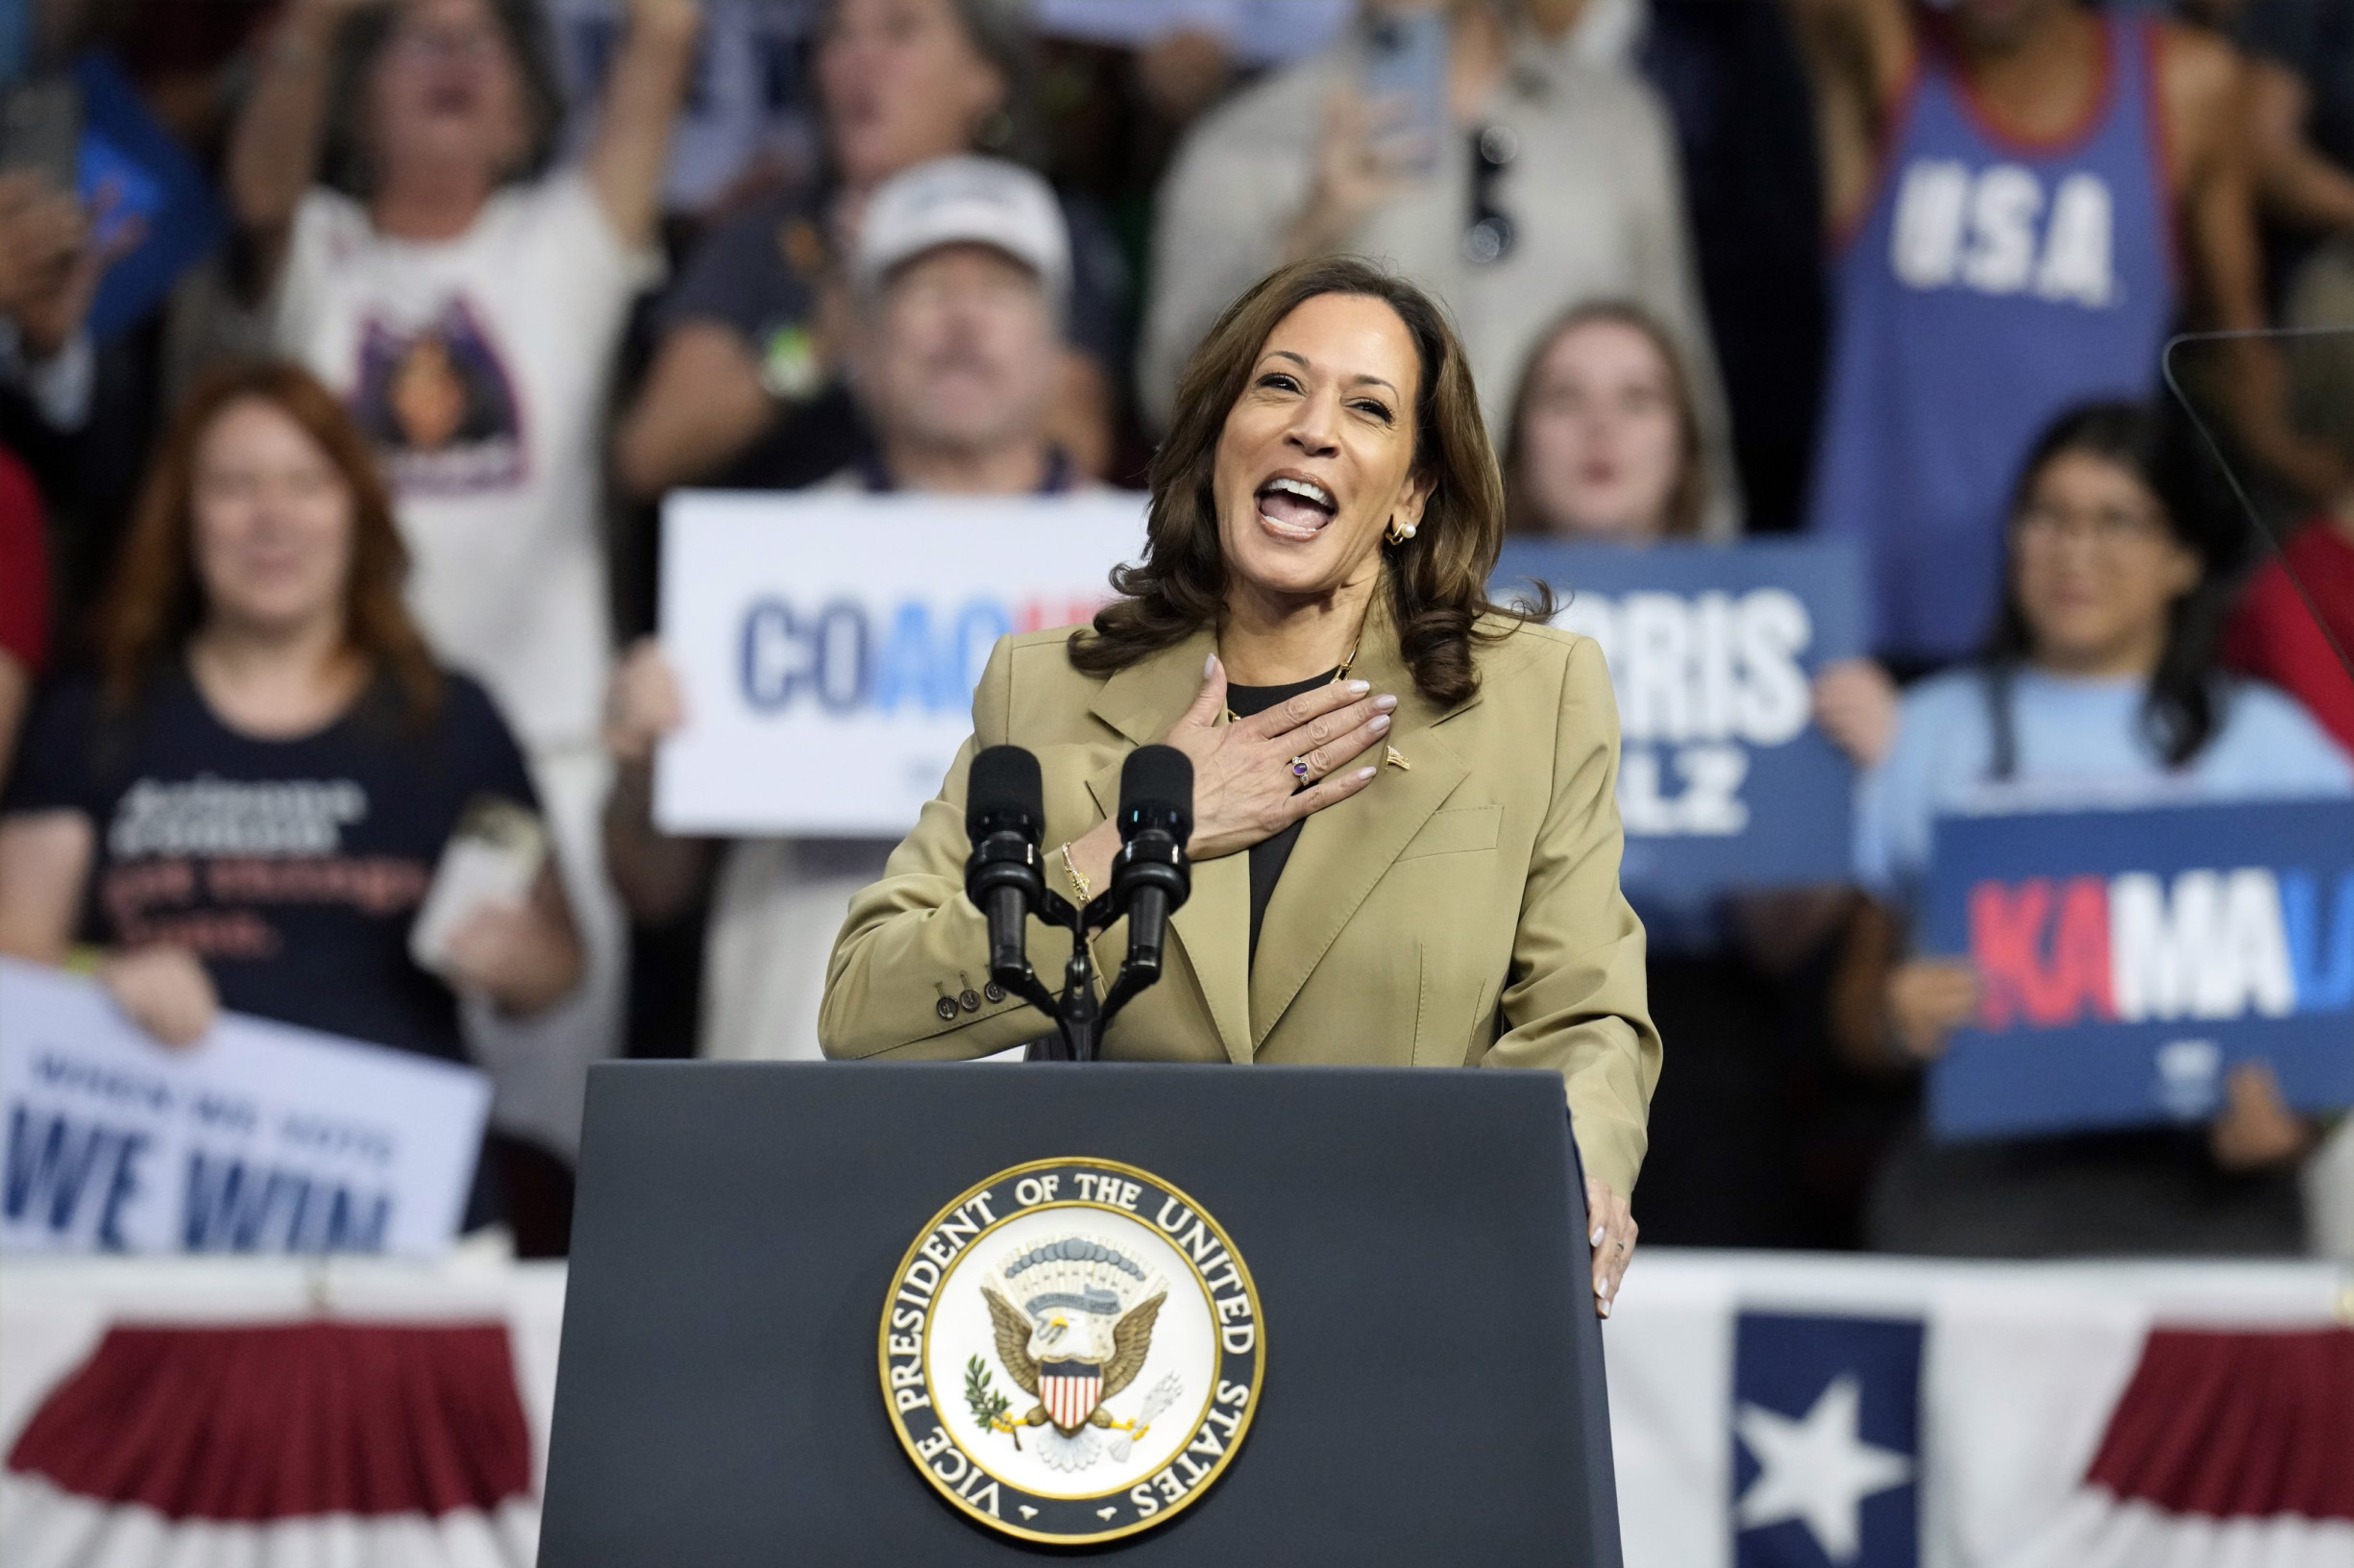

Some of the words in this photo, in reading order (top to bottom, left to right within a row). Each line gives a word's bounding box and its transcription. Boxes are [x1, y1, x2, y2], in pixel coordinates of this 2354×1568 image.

[1968, 867, 2354, 1035] KAMAL
[2, 1097, 151, 1252] WE
[182, 1148, 394, 1255] WIN
[1015, 1174, 1061, 1207] OF
[1073, 1172, 1142, 1211] THE
[889, 1190, 997, 1414] PRESIDENT
[1155, 1195, 1256, 1355] UNITED
[916, 1426, 1000, 1519] VICE
[1131, 1380, 1251, 1520] STATES
